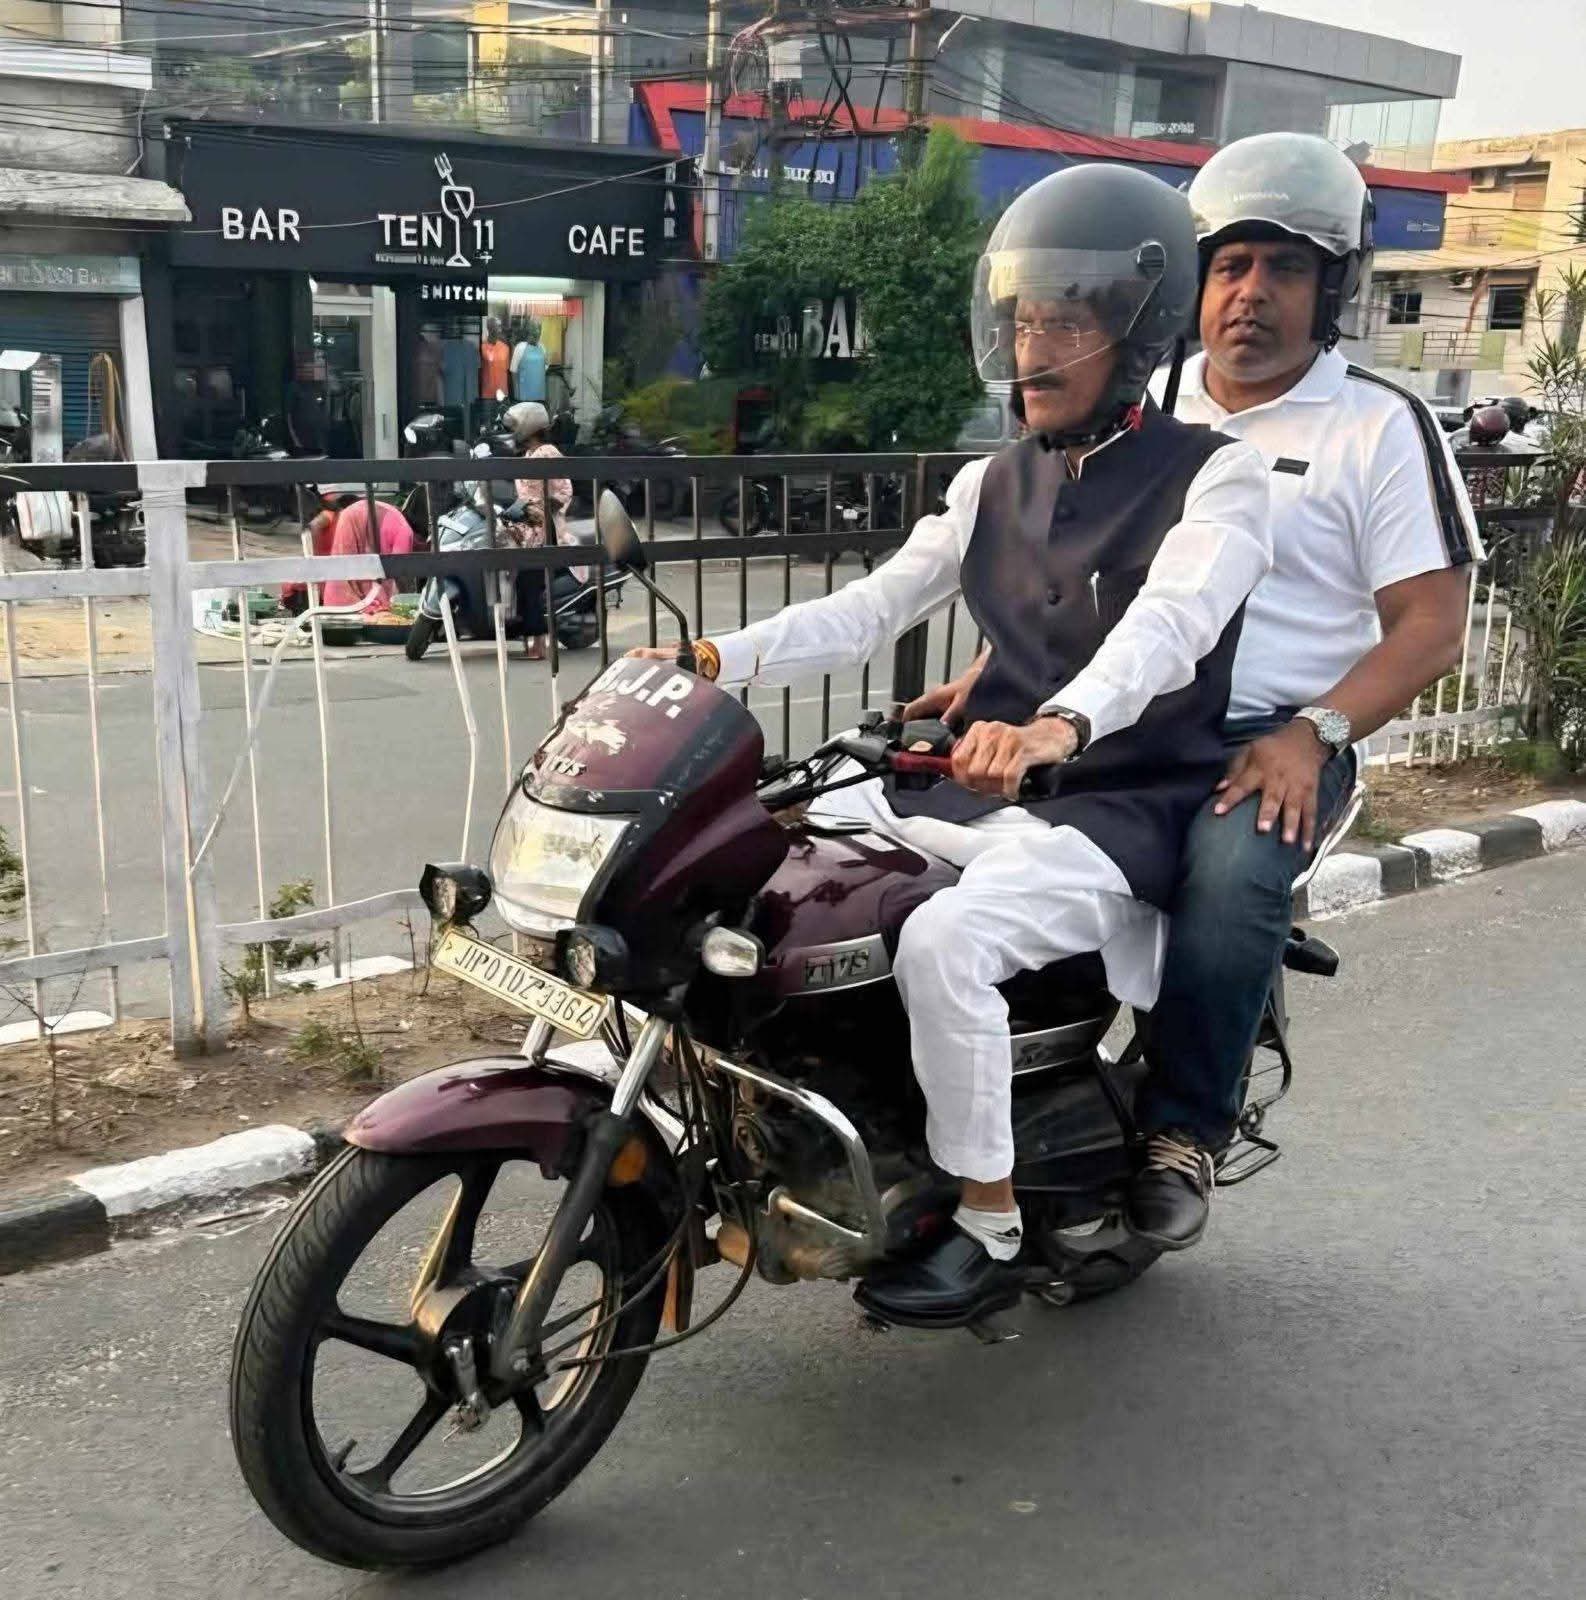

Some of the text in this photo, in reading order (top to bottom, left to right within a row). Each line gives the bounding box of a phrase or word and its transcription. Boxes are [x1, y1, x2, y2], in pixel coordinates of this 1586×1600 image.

[222, 207, 300, 242] BAR
[378, 213, 494, 250] TEN 11
[568, 224, 645, 256] CAFE
